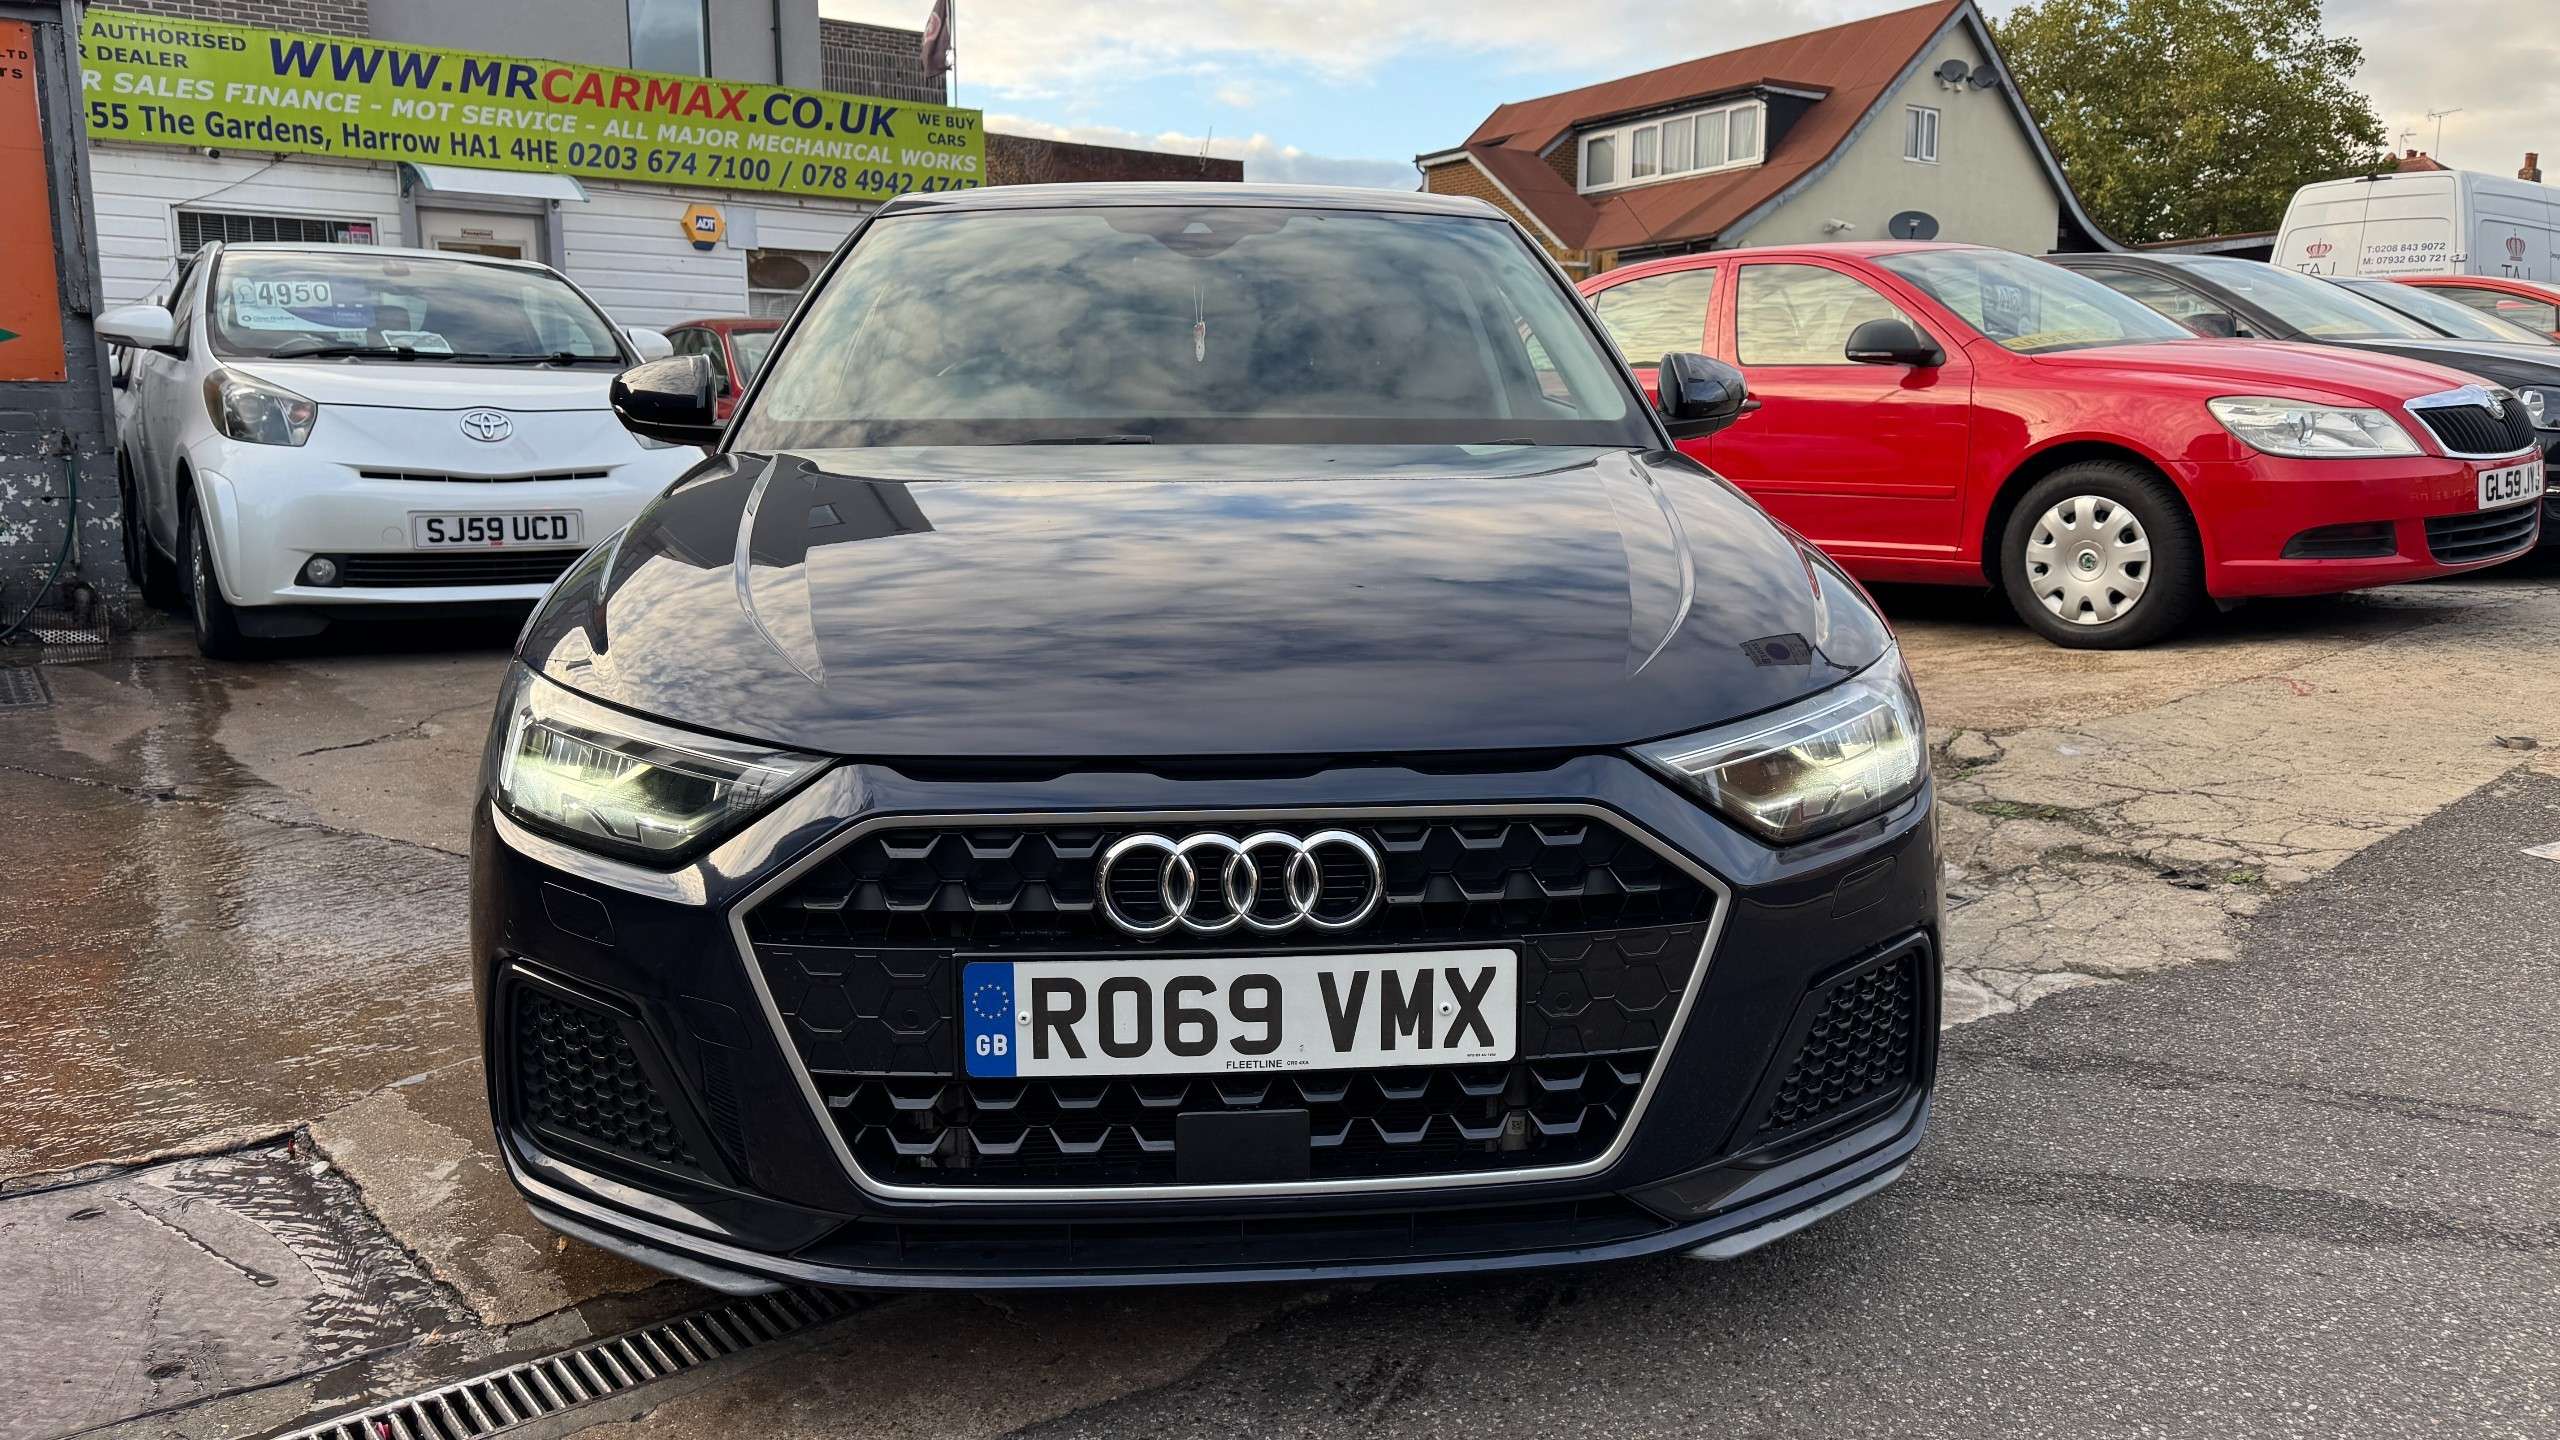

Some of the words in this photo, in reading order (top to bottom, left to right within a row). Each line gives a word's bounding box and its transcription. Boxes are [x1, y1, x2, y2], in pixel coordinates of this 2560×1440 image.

[92, 22, 247, 52] AUTHORISED
[97, 46, 189, 69] DEALER
[269, 37, 898, 138] WWW.MRCARMAX.CO.UK
[112, 72, 215, 101] SALES
[224, 82, 361, 114] FINANCE
[391, 98, 454, 122] MOT
[461, 104, 578, 133] SERVICE
[603, 119, 648, 140] ALL
[657, 124, 740, 149] MAJOR
[747, 133, 893, 164] MECHANICAL
[901, 149, 977, 173] WORKS
[917, 112, 941, 127] WE
[946, 116, 976, 130] BUY
[138, 105, 194, 135] The
[205, 111, 332, 151] Gardens,
[342, 122, 441, 155] Harrow
[450, 131, 501, 160] HA1
[511, 137, 559, 165] 4HE
[568, 142, 638, 171] 0203
[648, 149, 697, 176] 674
[707, 154, 771, 182] 7100
[778, 161, 792, 188] /
[802, 163, 847, 189] 078
[855, 168, 913, 194] 4942
[927, 132, 967, 147] CARS
[696, 218, 716, 231] ADT
[2400, 243, 2418, 252] 843
[2421, 242, 2446, 251] 9072
[2376, 255, 2405, 265] 07932
[2408, 254, 2426, 263] 630
[2429, 254, 2446, 262] 721
[238, 281, 329, 306] £4950
[2486, 470, 2521, 501] GL59
[426, 517, 504, 542] SJ59
[512, 515, 568, 540] UCD
[1031, 973, 1283, 1059] RO69
[1317, 966, 1497, 1053] VMX
[976, 1033, 1008, 1056] GB
[1226, 1059, 1283, 1069] FLEETLINE
